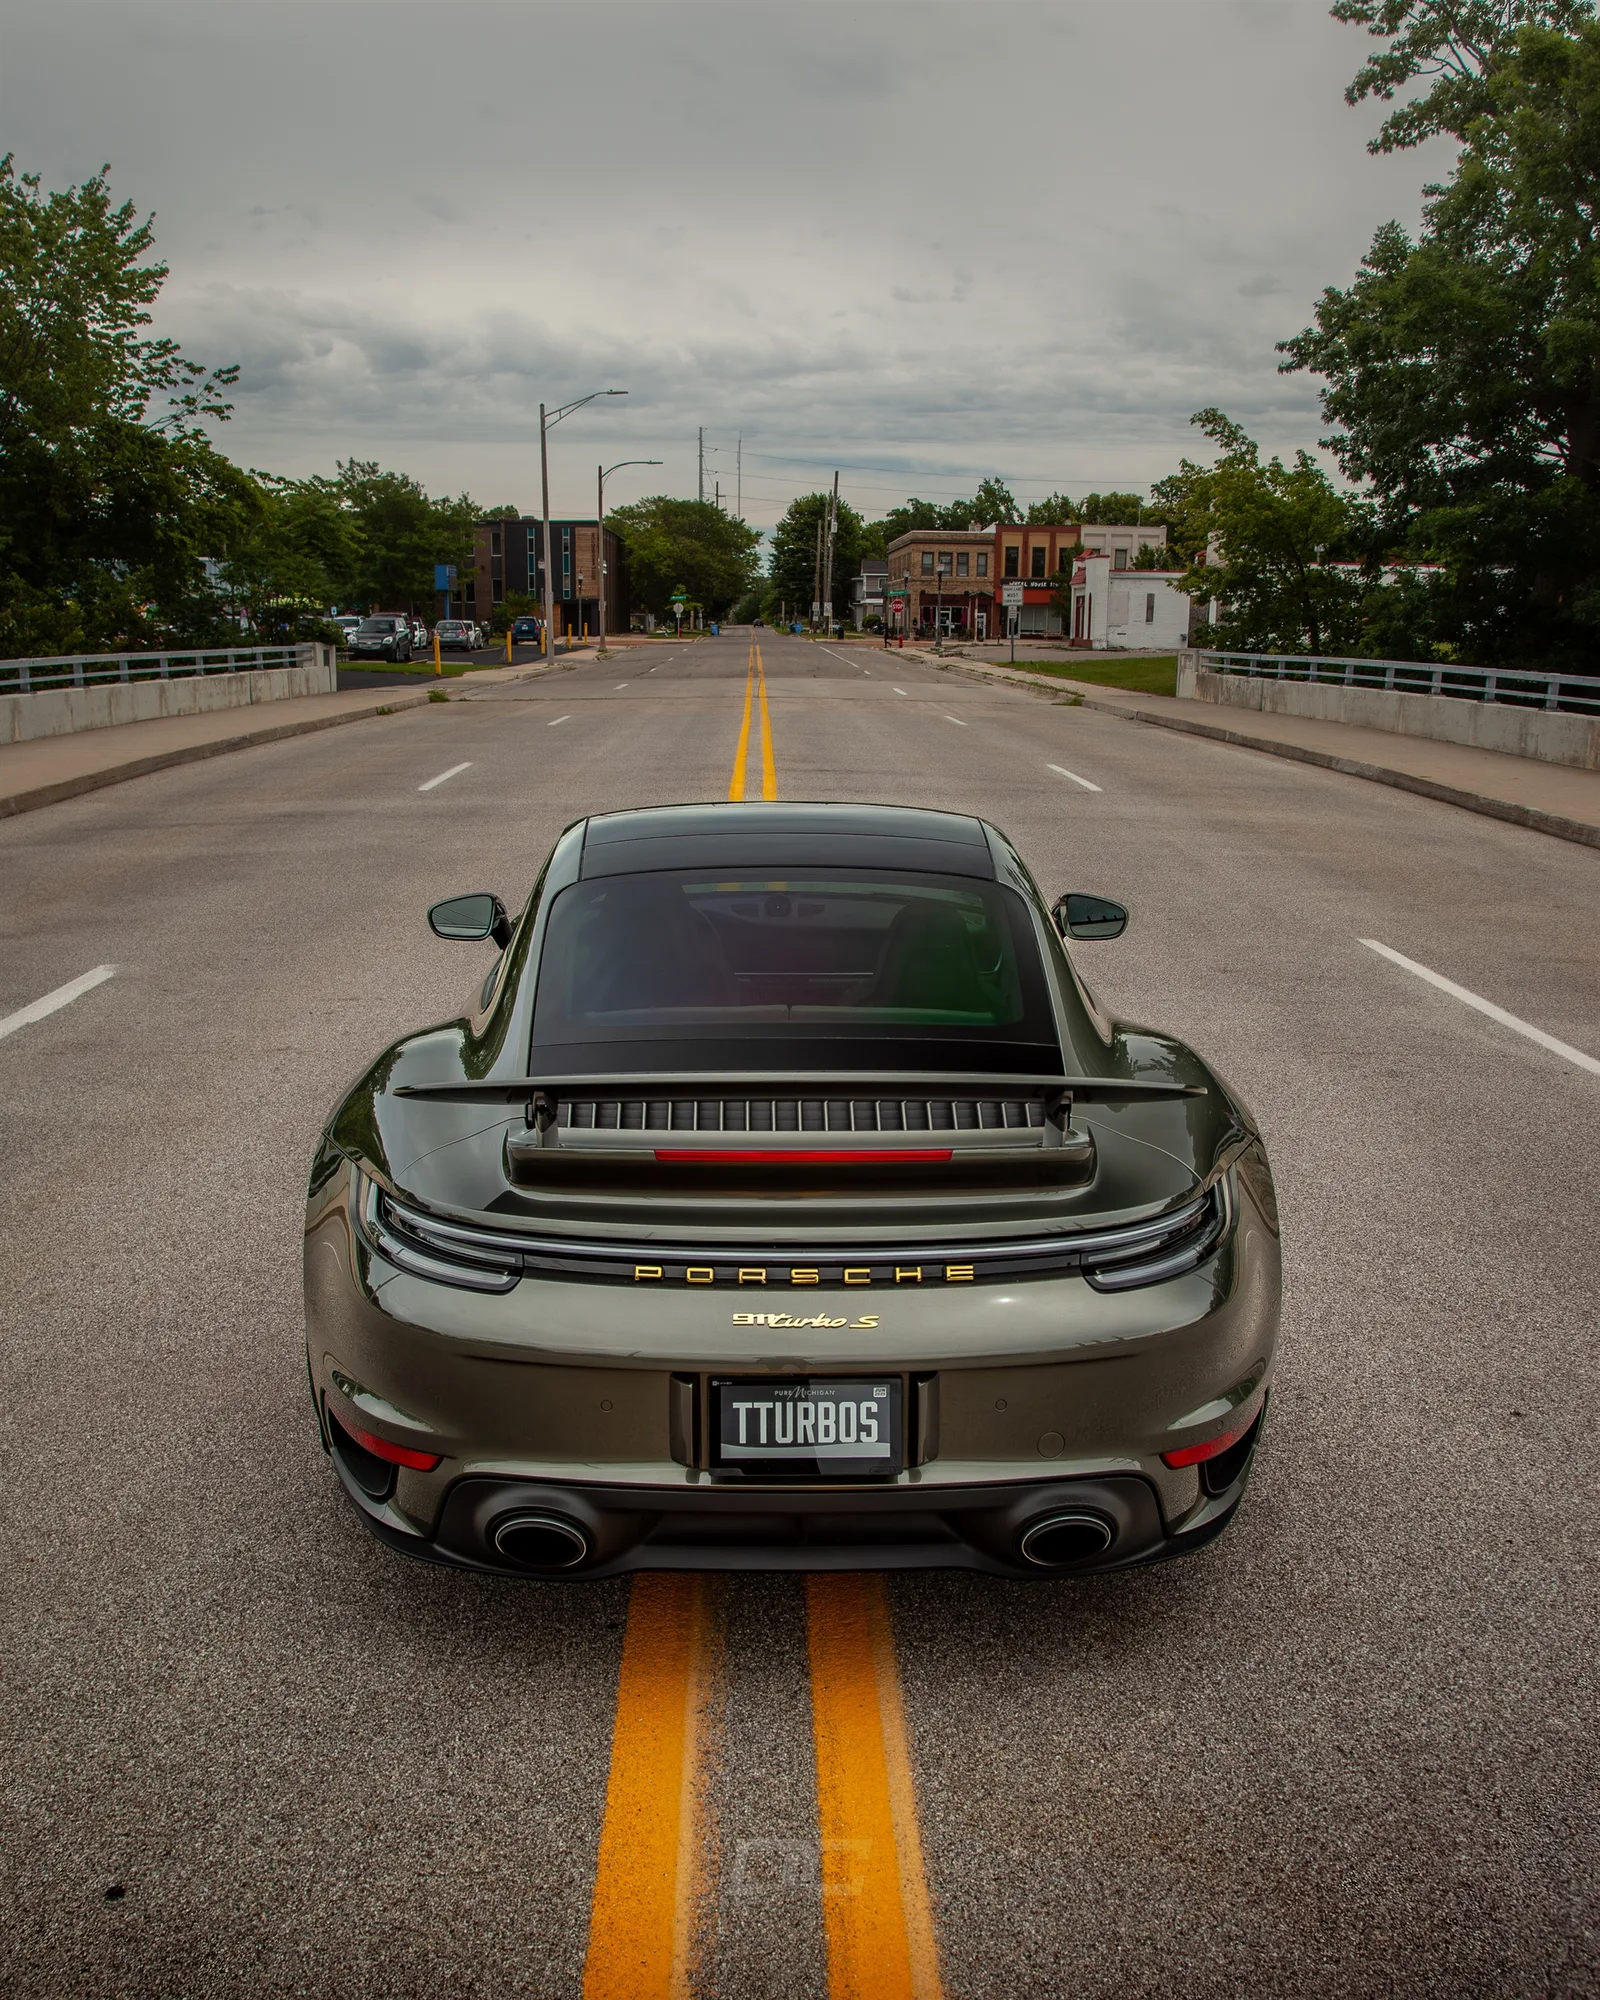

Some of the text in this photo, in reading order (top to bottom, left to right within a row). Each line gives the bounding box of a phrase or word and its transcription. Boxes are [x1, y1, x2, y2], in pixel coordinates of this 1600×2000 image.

[634, 1265, 974, 1284] PORSCHE
[849, 1315, 880, 1329] S
[732, 1401, 879, 1444] TTURBOS
